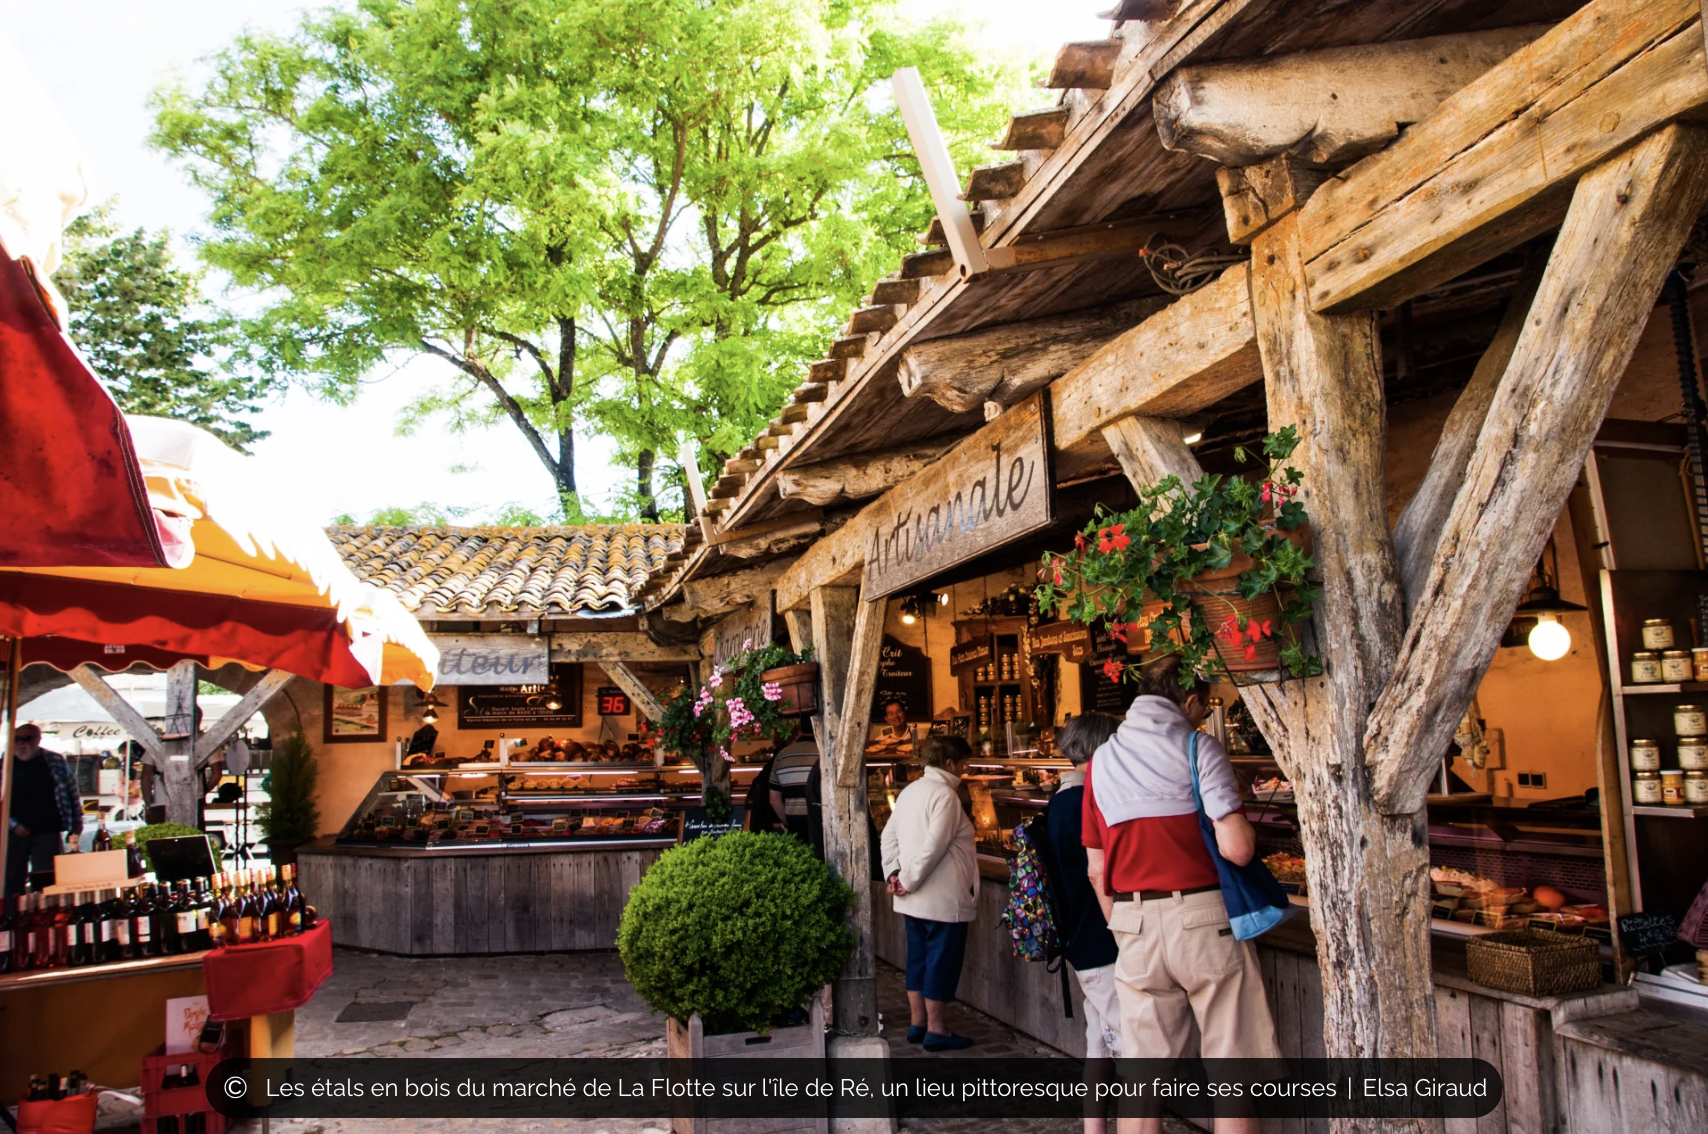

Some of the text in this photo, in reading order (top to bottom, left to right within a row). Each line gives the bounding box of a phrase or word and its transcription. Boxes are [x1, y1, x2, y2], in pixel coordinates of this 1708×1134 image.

[868, 440, 1035, 583] Artisanale
[880, 668, 913, 678] Traiteur
[602, 697, 625, 714] 36
[72, 725, 121, 738] Coffee
